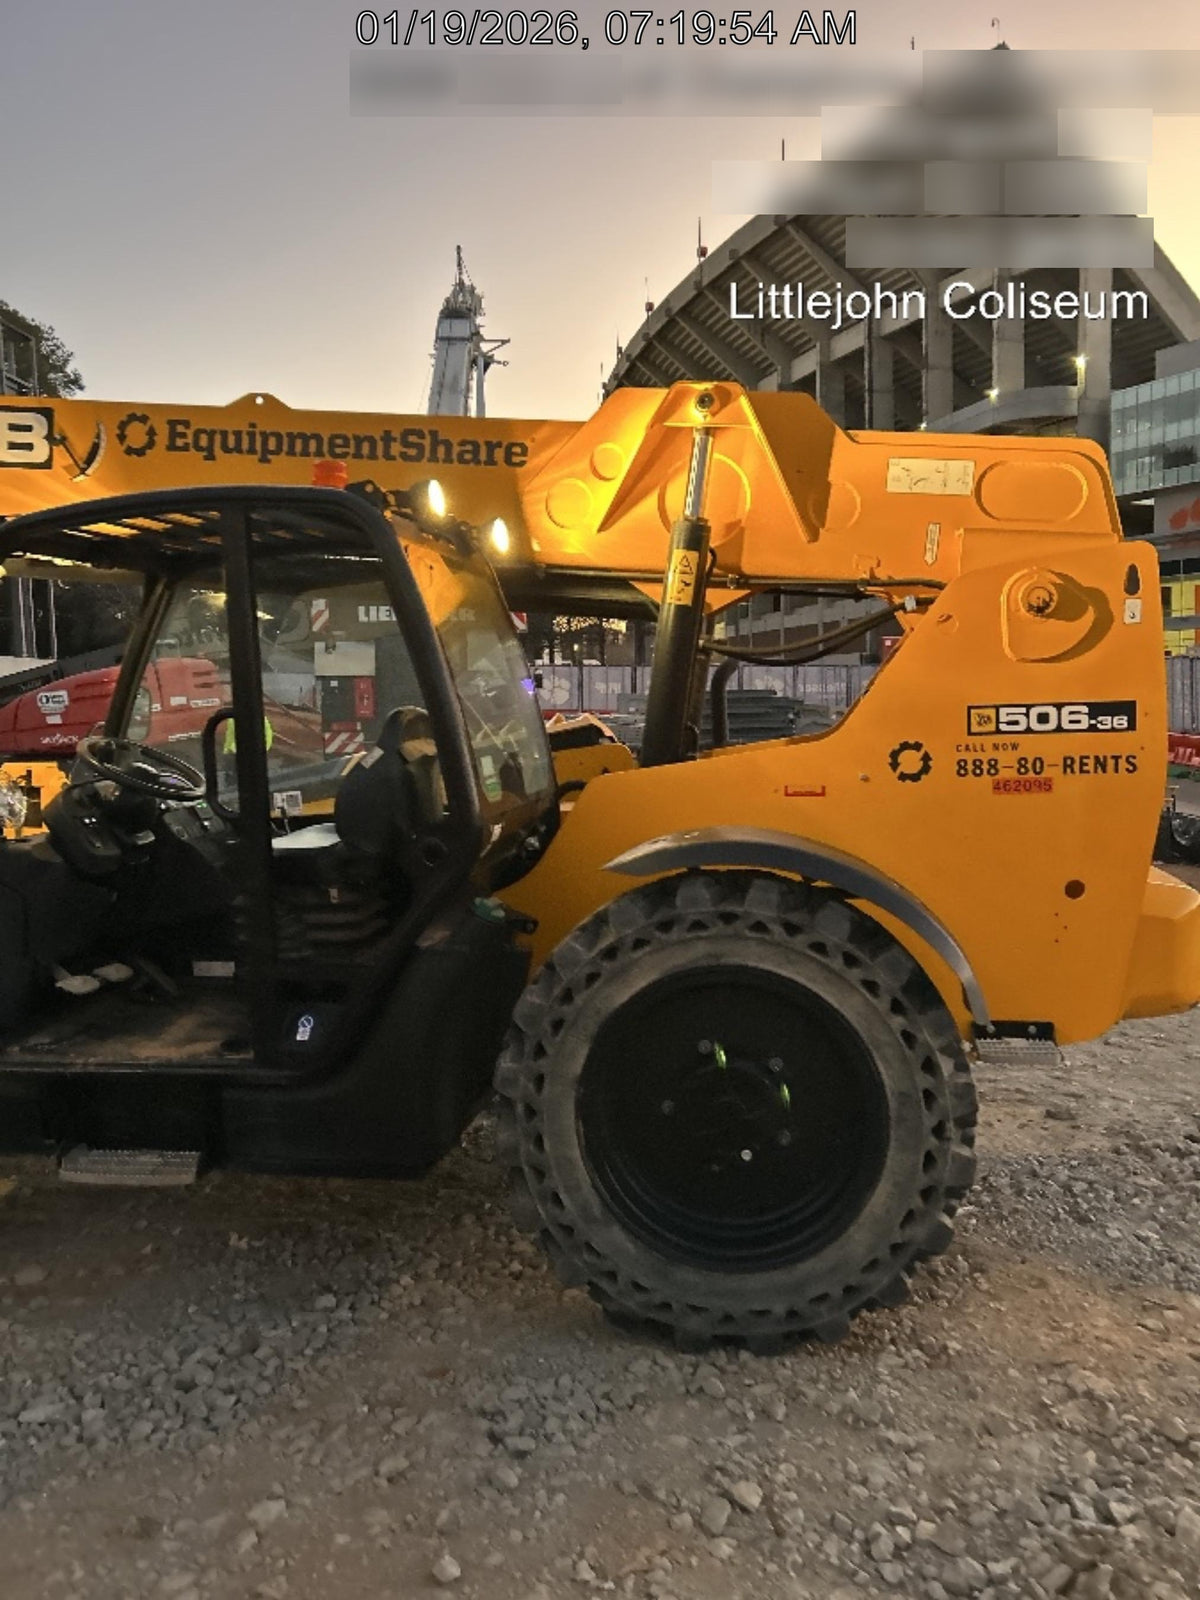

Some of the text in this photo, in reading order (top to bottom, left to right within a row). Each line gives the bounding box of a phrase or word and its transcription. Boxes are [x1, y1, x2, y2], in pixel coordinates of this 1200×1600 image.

[166, 418, 530, 468] EquipmentShare
[999, 705, 1128, 732] 506-36
[956, 742, 1020, 753] CALL NOW
[956, 754, 1138, 778] 888-80-RENTS
[993, 779, 1053, 793] 462095
